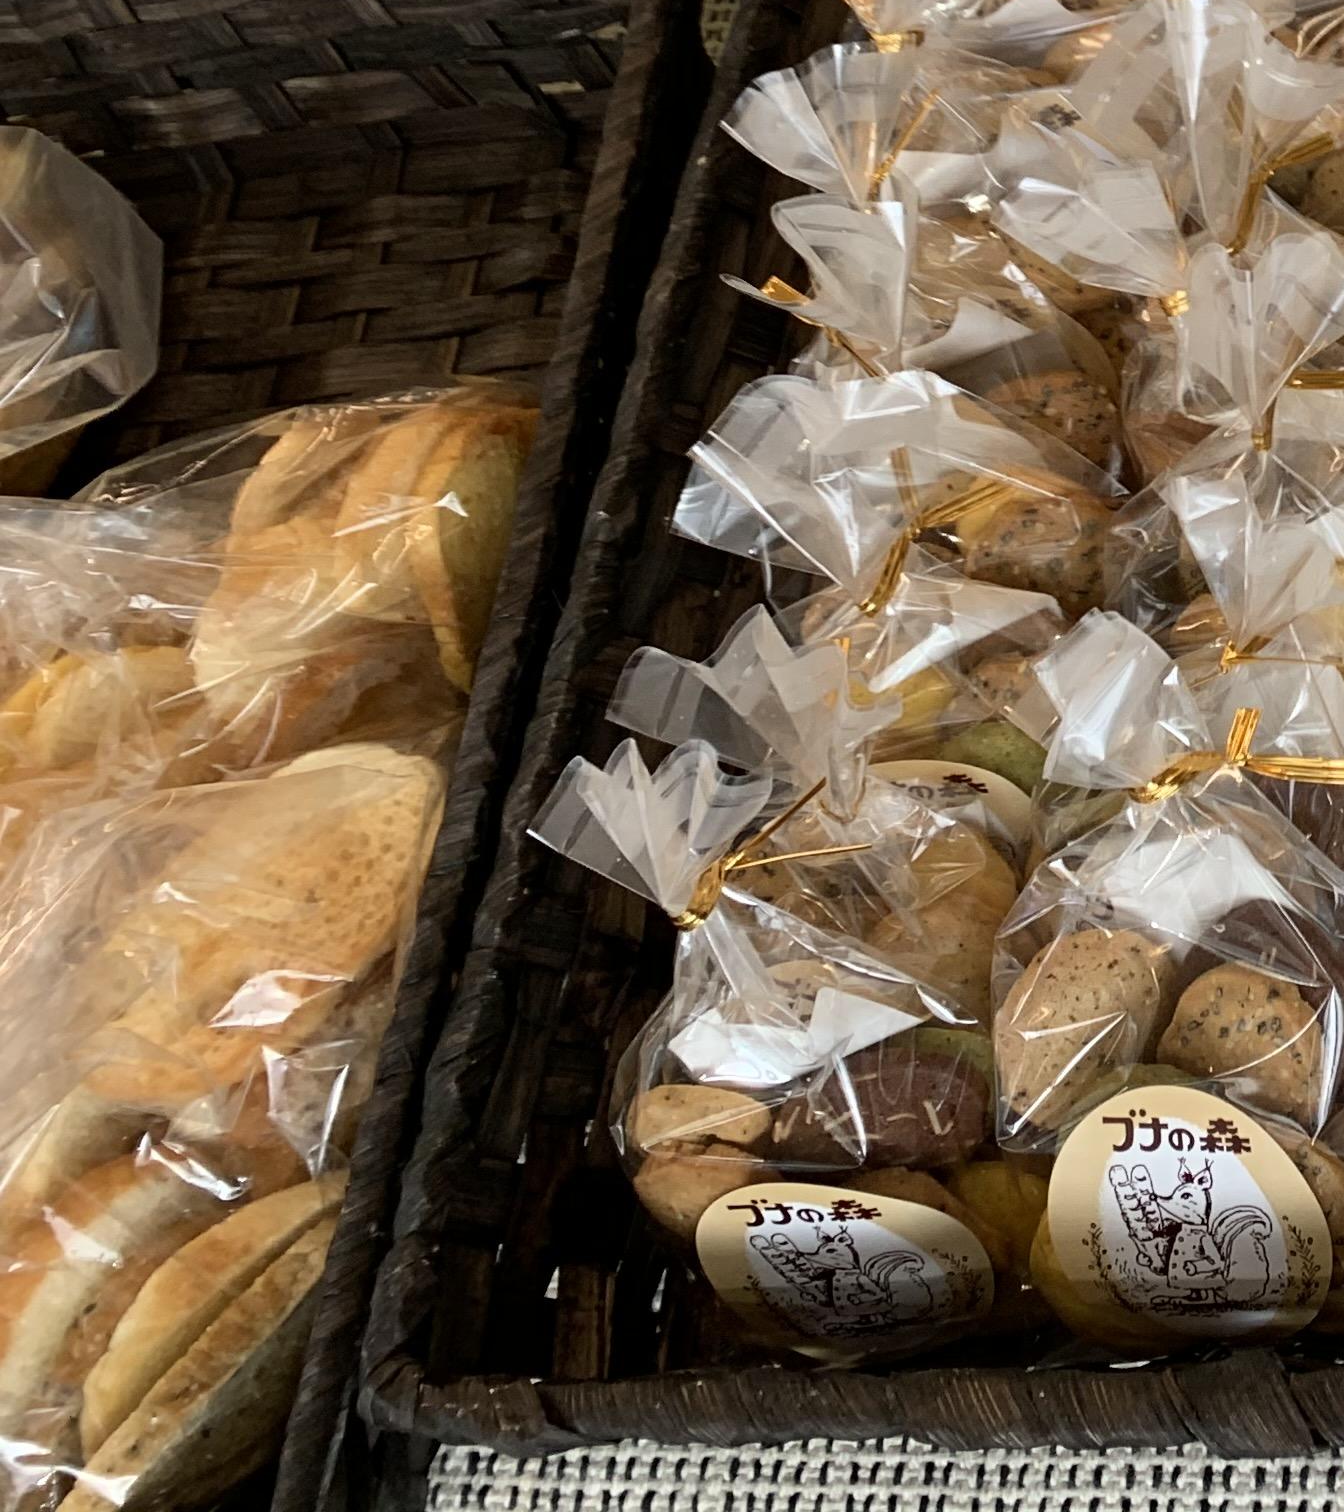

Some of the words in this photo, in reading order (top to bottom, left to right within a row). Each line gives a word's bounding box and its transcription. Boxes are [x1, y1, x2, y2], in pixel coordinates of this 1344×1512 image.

[1102, 1108, 1252, 1155] ブナの森
[726, 1198, 883, 1228] ブナの森
